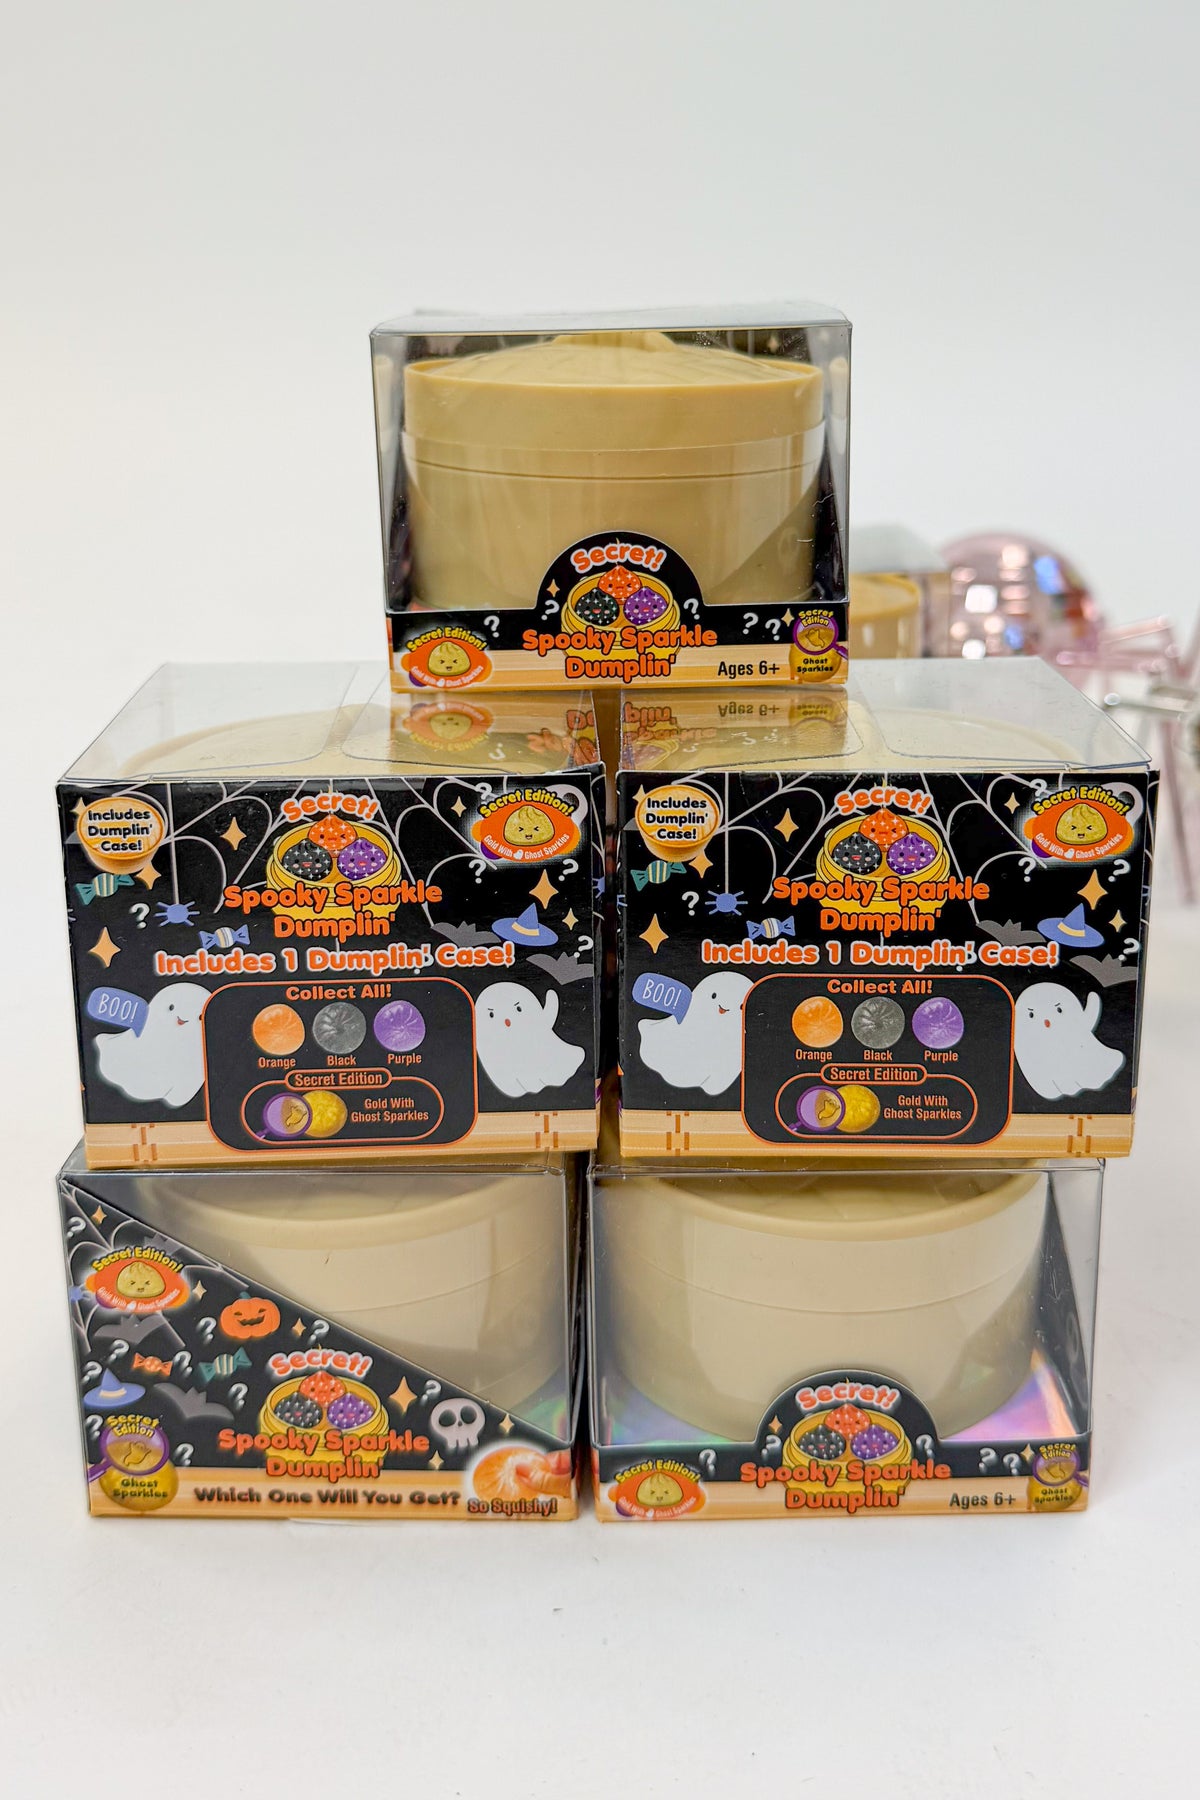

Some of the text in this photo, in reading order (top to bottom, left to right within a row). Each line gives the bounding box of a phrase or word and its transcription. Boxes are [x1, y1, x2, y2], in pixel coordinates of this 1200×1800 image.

[571, 543, 667, 573] Secret!
[798, 609, 834, 619] Secret
[801, 616, 830, 627] Edition
[407, 627, 487, 651] Secret Edition!
[522, 624, 718, 657] Spooky Sparkle
[565, 653, 677, 683] Dumplin'
[717, 660, 780, 679] Ages 6+
[797, 665, 834, 674] Sparkles
[282, 793, 380, 821] Secret!
[479, 788, 575, 818] Secret Edition!
[647, 797, 707, 808] Includes
[835, 787, 933, 816] Secret!
[1032, 786, 1130, 815] Secret Edition!
[88, 808, 151, 820] Includes
[645, 812, 708, 827] Dumplin'
[88, 823, 152, 838] Dumplin'
[657, 828, 697, 839] Case!
[101, 840, 142, 851] Case!
[498, 846, 513, 858] With
[524, 850, 544, 859] Ghost
[543, 833, 570, 855] Sparkles
[1048, 843, 1064, 856] With
[1076, 849, 1095, 859] Ghost
[1096, 833, 1123, 855] Sparkles
[223, 879, 443, 915] Spooky Sparkle
[772, 875, 990, 906] Spooky Sparkle
[273, 910, 396, 943] Dumplin'
[819, 906, 942, 937] Dumplin'
[154, 941, 515, 976] Includes 1 Dumplin' Case!
[702, 938, 1059, 972] Includes 1 Dumplin' Case!
[285, 984, 392, 1001] Collect All!
[642, 979, 683, 1009] BOO!
[827, 979, 933, 994] Collect All!
[98, 993, 139, 1023] BOO!
[257, 1053, 422, 1069] Orange Black Purple
[795, 1049, 958, 1063] Orange Black Purple
[295, 1072, 383, 1087] Secret Edition
[830, 1067, 918, 1081] Secret Edition
[364, 1098, 414, 1109] Gold With
[898, 1095, 948, 1106] Gold With
[351, 1110, 429, 1123] Ghost Sparkles
[884, 1108, 961, 1121] Ghost Sparkles
[92, 1246, 184, 1273] Secret Edition!
[269, 1349, 373, 1377] Secret!
[796, 1382, 900, 1409] Secret!
[107, 1414, 159, 1428] Secret
[113, 1423, 155, 1438] Edition
[218, 1427, 430, 1456] Spooky Sparkle
[1040, 1443, 1076, 1452] Secret
[1042, 1450, 1071, 1460] Edition
[266, 1455, 384, 1483] Dumplin'
[615, 1459, 700, 1482] Secret Edition!
[740, 1459, 951, 1488] Spooky Sparkle
[121, 1478, 158, 1487] Ghost
[113, 1489, 168, 1499] Sparkles
[194, 1487, 461, 1505] Which One Will You Get?
[785, 1485, 905, 1513] Dumplin'
[950, 1492, 1016, 1509] Ages 6+
[467, 1497, 557, 1516] So Squishy!
